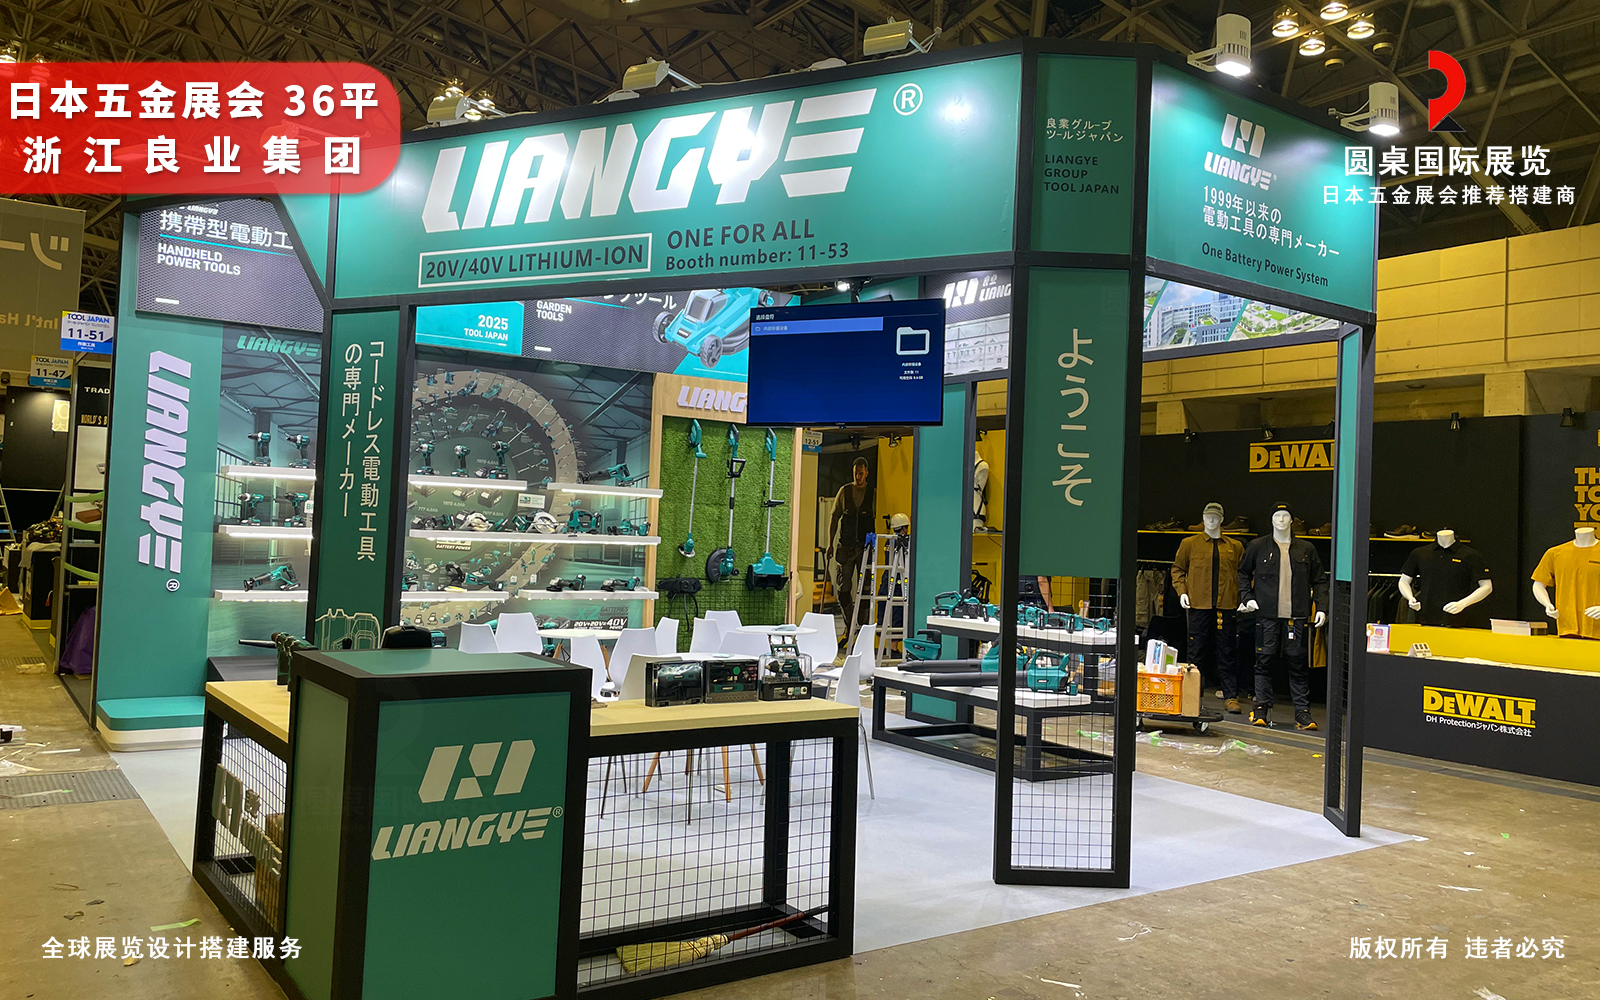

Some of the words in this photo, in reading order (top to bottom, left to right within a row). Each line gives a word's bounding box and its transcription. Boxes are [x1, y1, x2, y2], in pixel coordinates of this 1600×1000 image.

[1045, 154, 1098, 166] LIANGYE
[1044, 168, 1088, 179] GROUP
[1044, 181, 1076, 192] TOOL
[1079, 183, 1119, 194] JAPAN
[1203, 185, 1282, 224] 1999年以来の
[667, 227, 713, 249] ONE
[721, 223, 766, 246] FOR
[772, 219, 815, 241] ALL
[1203, 205, 1340, 257] 電動工具の専門メーカー
[157, 243, 223, 262] HANDHELD
[666, 252, 714, 271] Booth
[719, 248, 792, 267] number:
[797, 242, 849, 261] 11-53
[157, 253, 201, 270] POWER
[203, 260, 241, 275] TOOLS
[425, 256, 503, 279] 20V/40V
[508, 244, 643, 272] LITHIUM-ION
[1201, 242, 1223, 259] One
[1225, 247, 1263, 272] Battery
[1264, 259, 1294, 277] Power
[1296, 267, 1329, 287] System
[536, 300, 572, 314] GARDEN
[67, 313, 86, 321] TOOL
[87, 315, 110, 323] JAPAN
[478, 315, 509, 330] 2025
[536, 309, 564, 322] TOOLS
[68, 327, 104, 340] 11-51
[464, 328, 484, 338] TOOL
[485, 329, 509, 341] JAPAN
[36, 368, 66, 378] 11-47
[84, 386, 110, 394] TRAD
[1052, 328, 1094, 507] ようこそ
[339, 343, 362, 517] の専門メーカー
[357, 340, 385, 562] コードレス電動工具
[1425, 715, 1437, 723] DH
